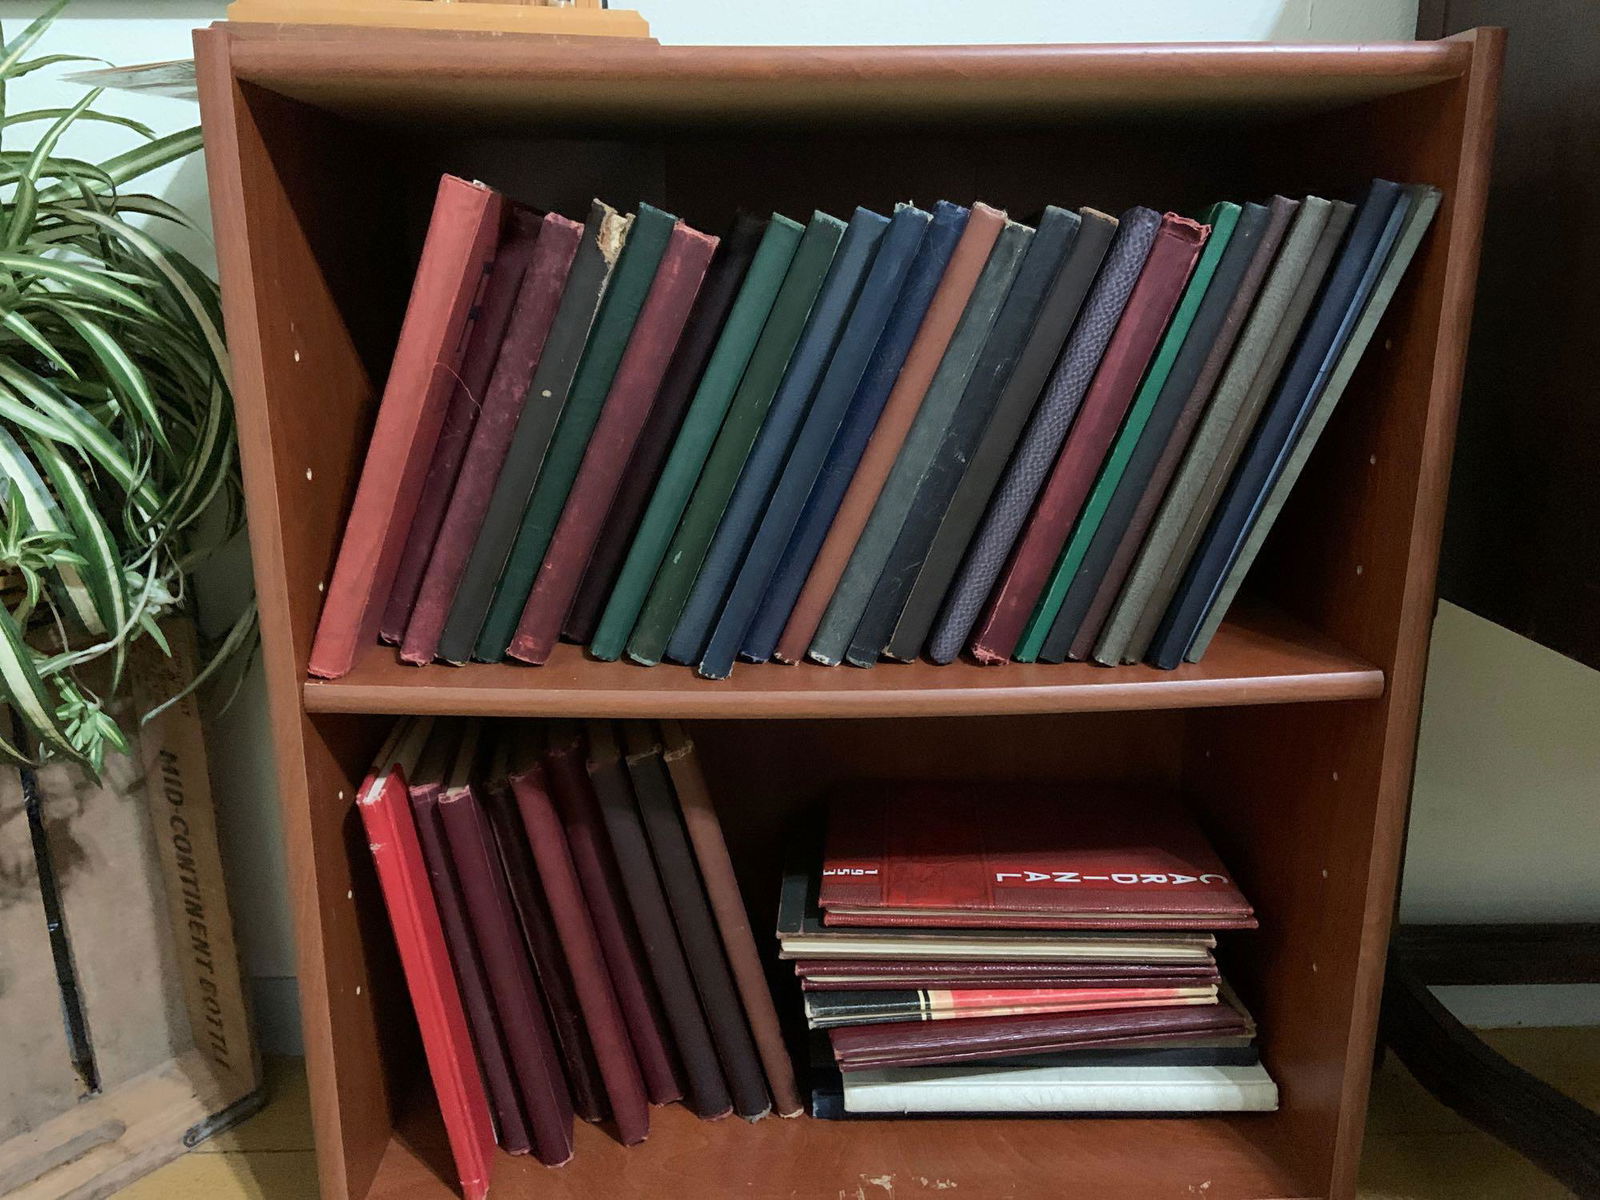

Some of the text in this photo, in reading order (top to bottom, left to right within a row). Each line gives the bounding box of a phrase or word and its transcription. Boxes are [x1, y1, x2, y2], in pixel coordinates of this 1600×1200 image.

[159, 749, 214, 975] MID-CONTINENT
[822, 868, 879, 876] 1953
[996, 870, 1229, 885] CARDINAL
